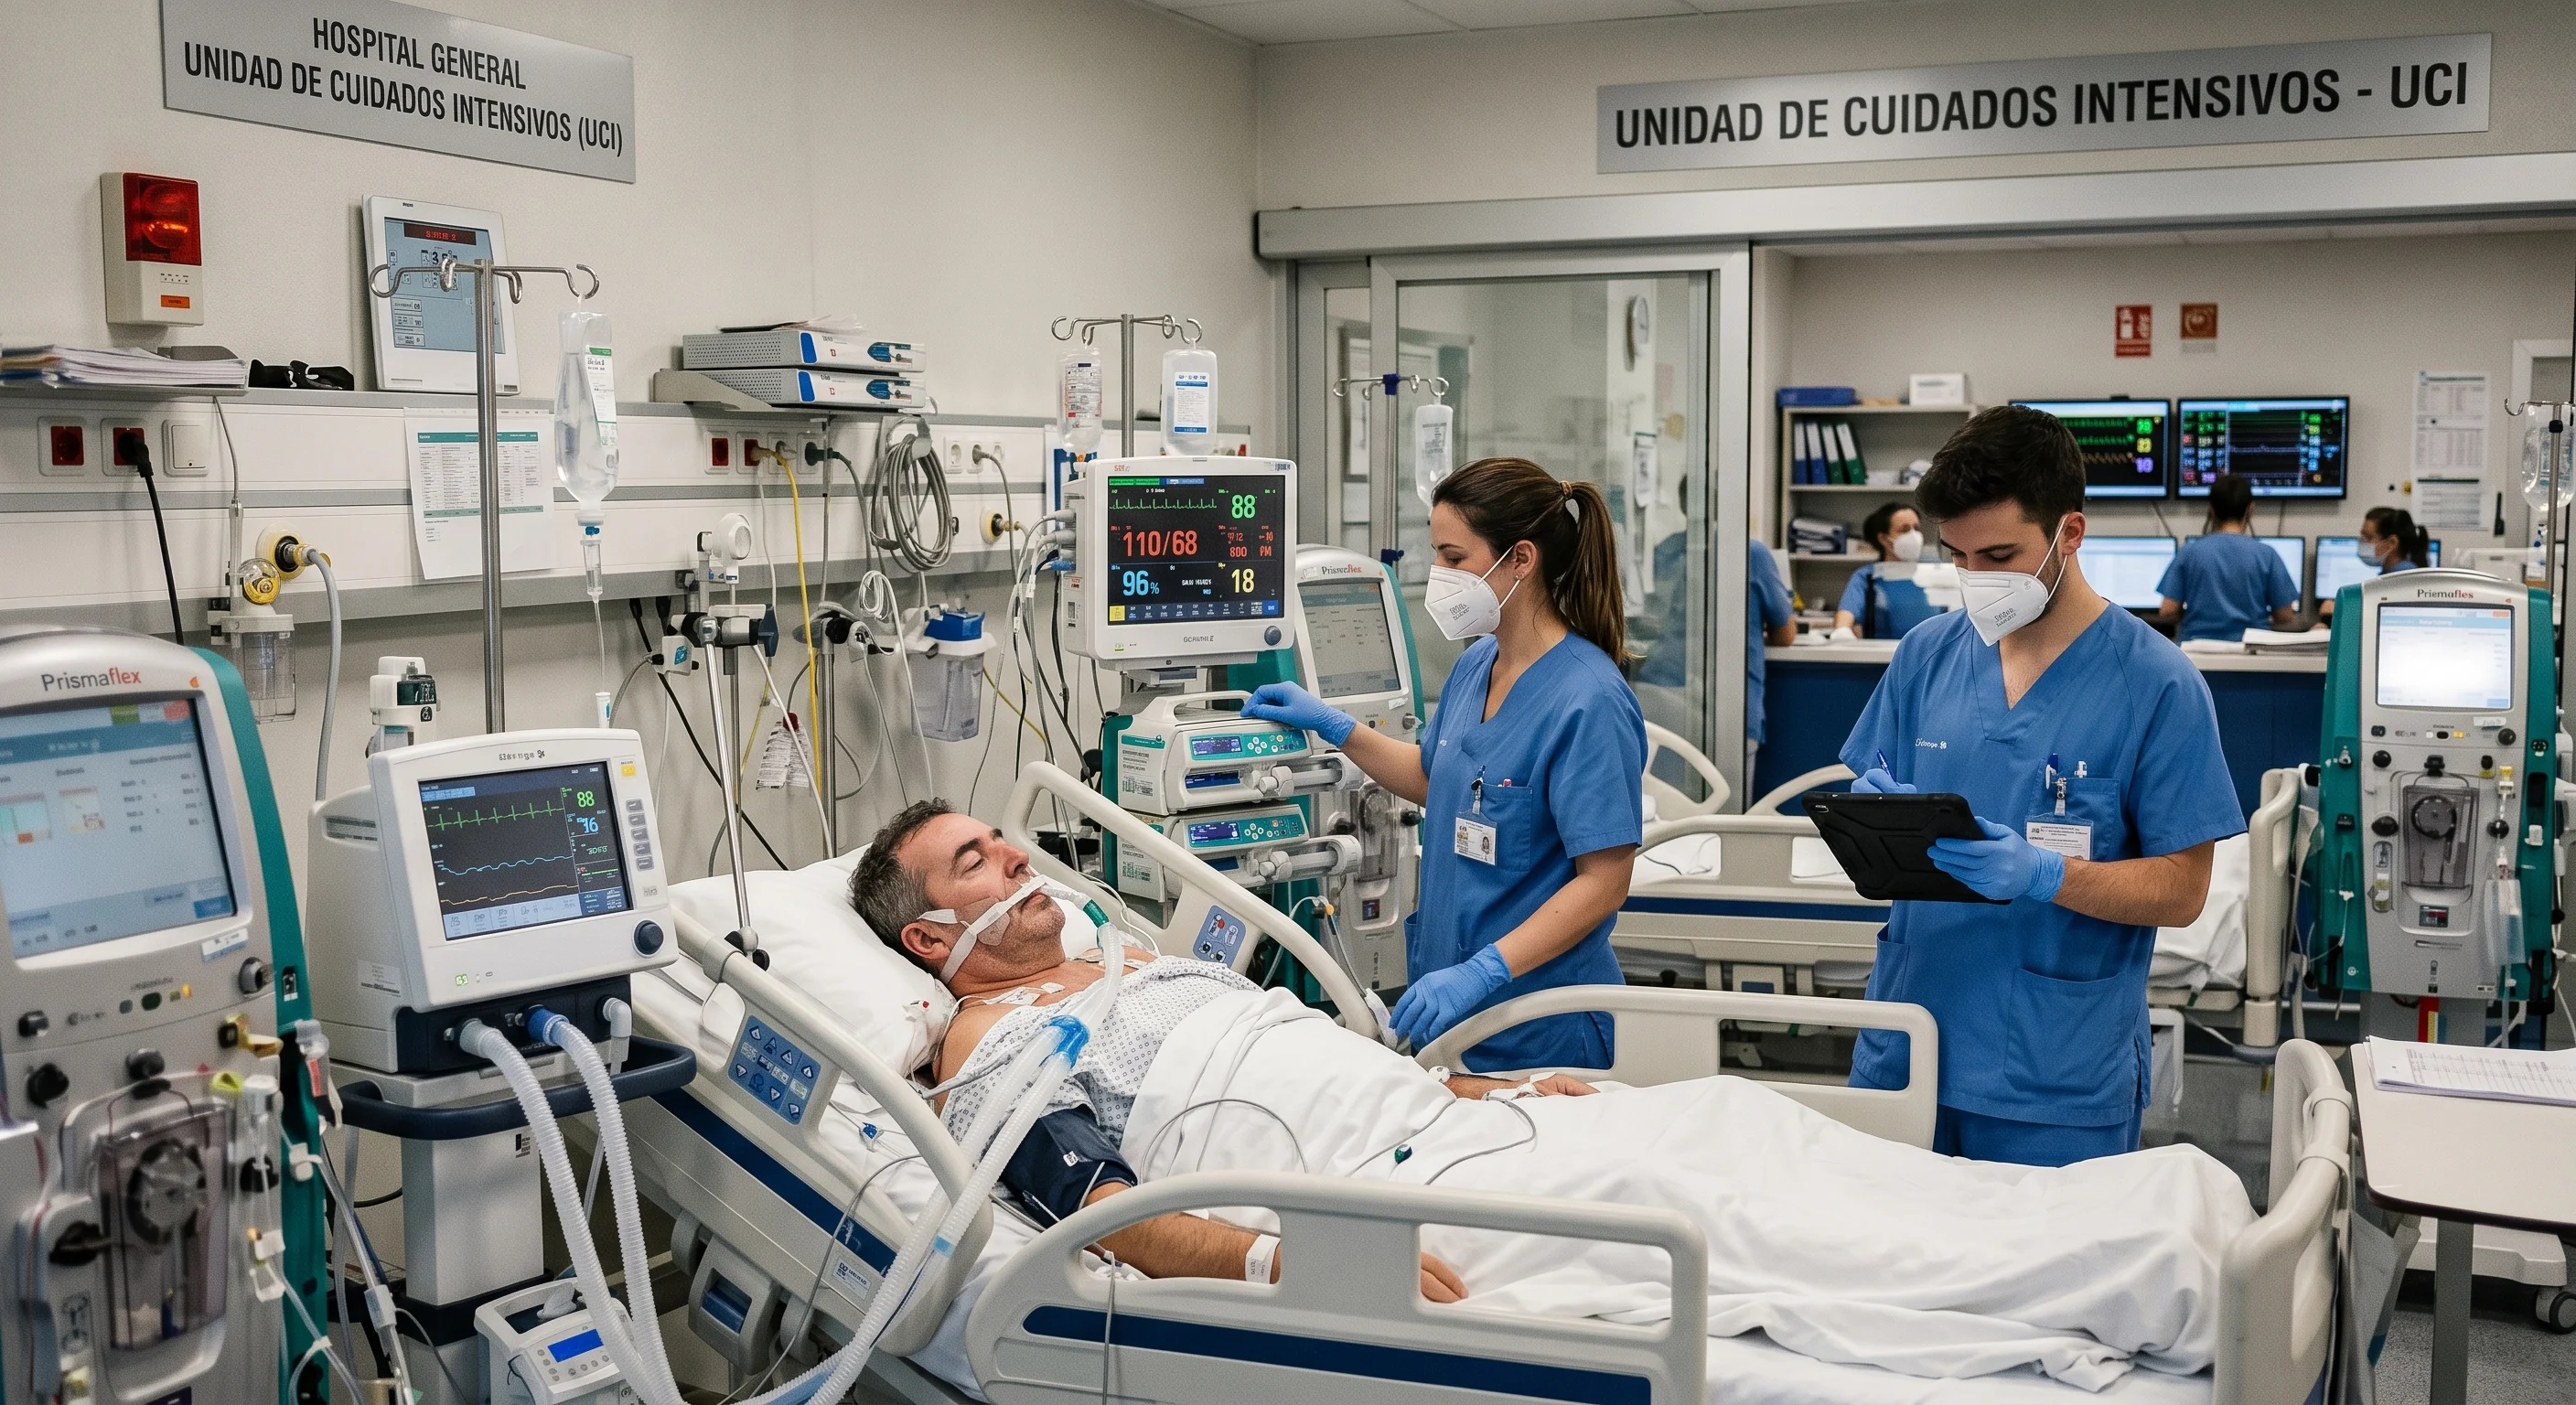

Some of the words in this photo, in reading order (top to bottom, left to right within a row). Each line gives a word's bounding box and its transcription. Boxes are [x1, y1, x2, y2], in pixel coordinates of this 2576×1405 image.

[313, 16, 425, 71] HOSPITAL
[431, 42, 527, 91] GENERAL
[185, 41, 283, 91] UNIDAD
[292, 61, 323, 99] DE
[330, 69, 446, 121] CUIDADOS
[453, 92, 572, 143] INTENSIVOS
[578, 116, 624, 158] (UCI)
[1615, 102, 1764, 148] UNIDAD
[1778, 98, 1830, 140] DE
[1843, 84, 2058, 137] CUIDADOS
[2073, 69, 2341, 125] INTENSIVOS
[2390, 61, 2468, 110] UCI
[1231, 494, 1256, 519] 88
[1122, 530, 1197, 557] 110/68
[1231, 568, 1255, 594] 18
[41, 667, 143, 692] Prismaflex
[576, 790, 596, 808] 88
